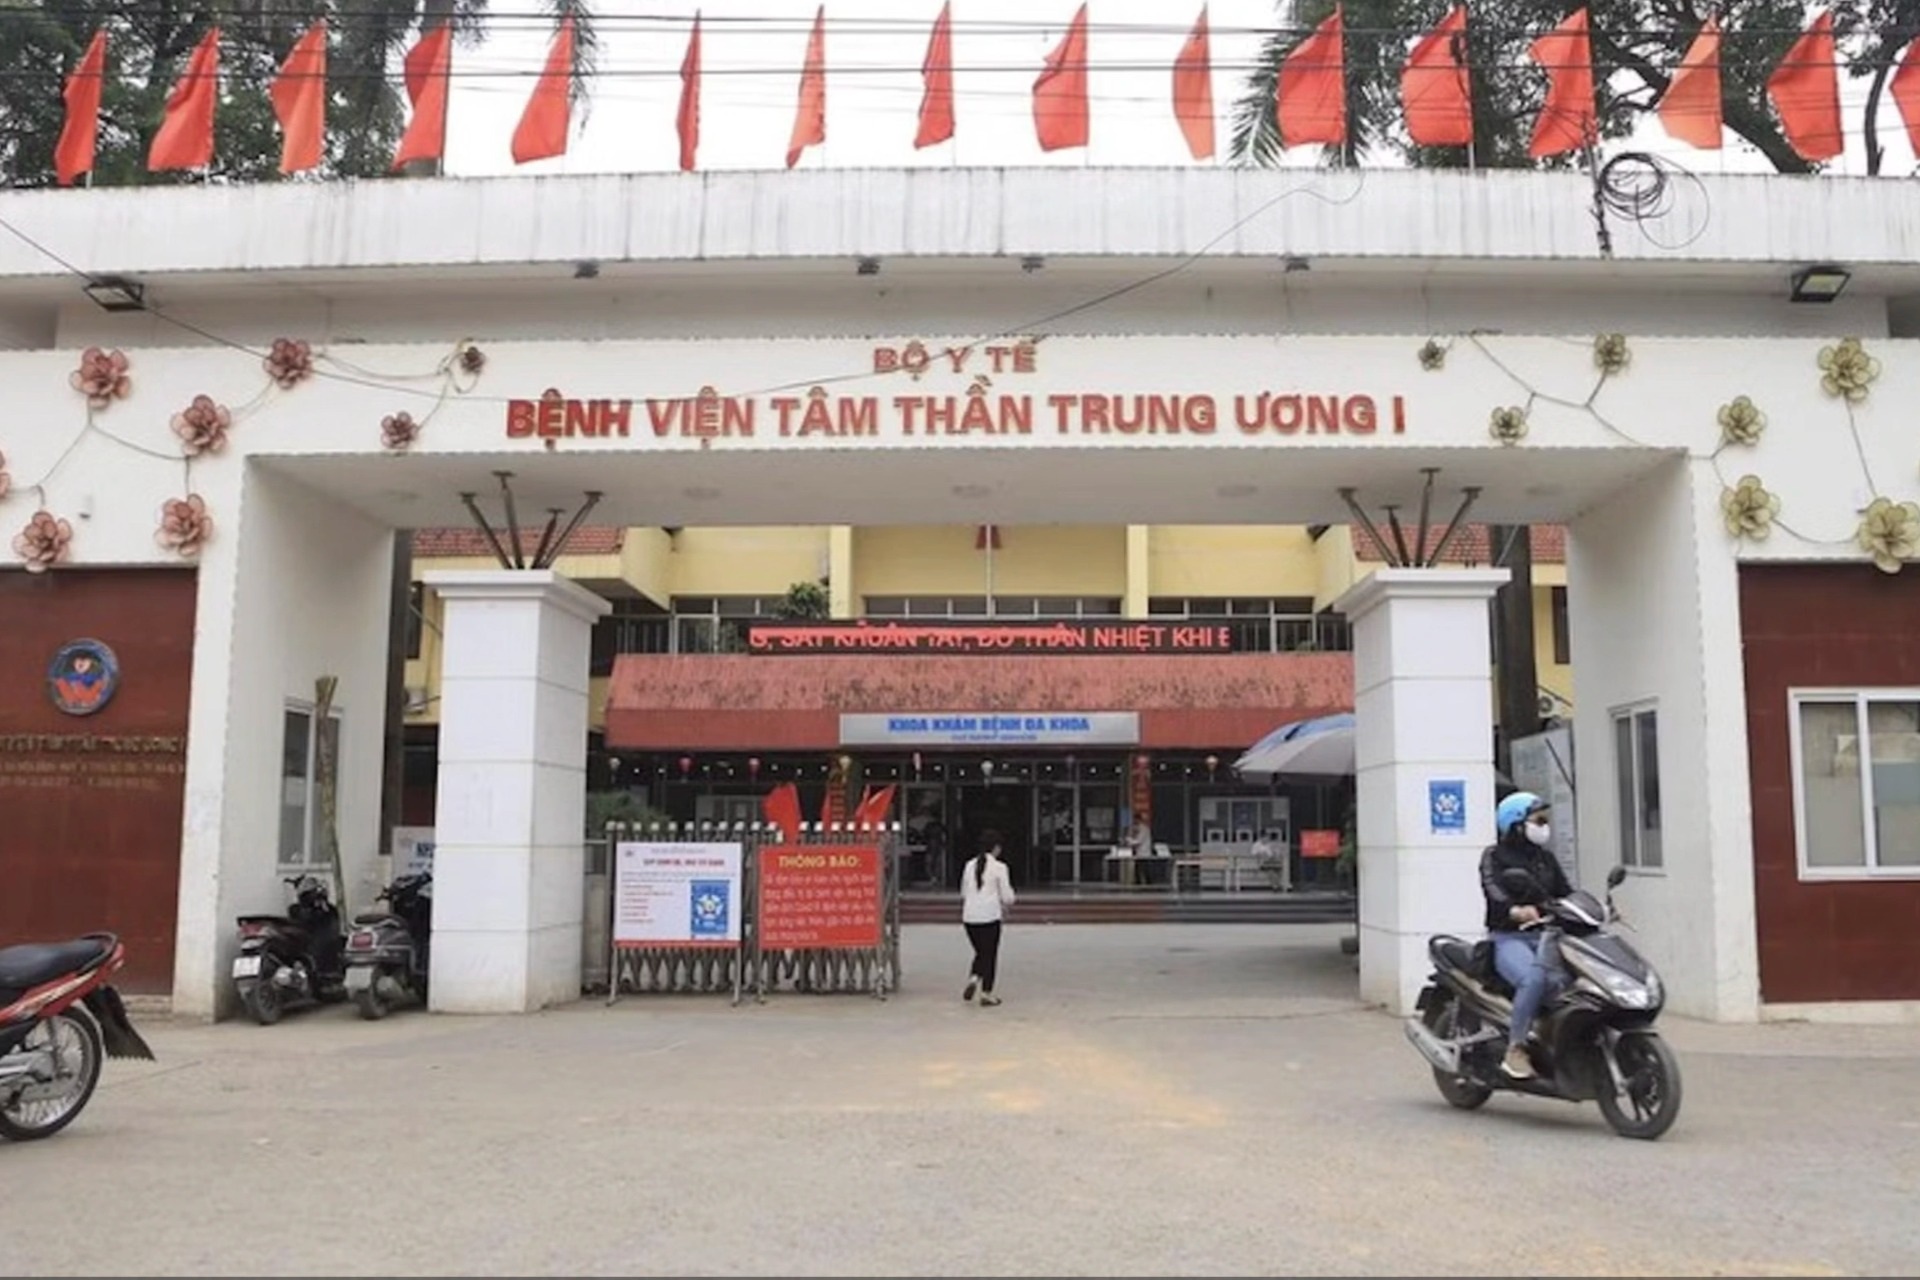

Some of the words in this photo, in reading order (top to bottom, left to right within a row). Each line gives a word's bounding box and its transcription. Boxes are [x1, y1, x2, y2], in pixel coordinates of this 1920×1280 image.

[873, 339, 930, 382] BỘ
[945, 345, 975, 373] Y
[985, 338, 1037, 373] TẾ
[506, 388, 631, 451] BỆNH
[645, 386, 755, 450] VIỆN
[770, 386, 878, 436] TÂM
[893, 374, 1033, 437] THẦN
[1047, 394, 1217, 434] TRUNG
[1235, 390, 1377, 434] ƯƠNG
[1393, 396, 1405, 433] I
[1093, 626, 1166, 651] NHIỆT
[1171, 626, 1212, 648] KHI
[888, 717, 928, 731] KHOA
[1051, 717, 1090, 731] KHOA
[778, 853, 826, 868] THÔNG
